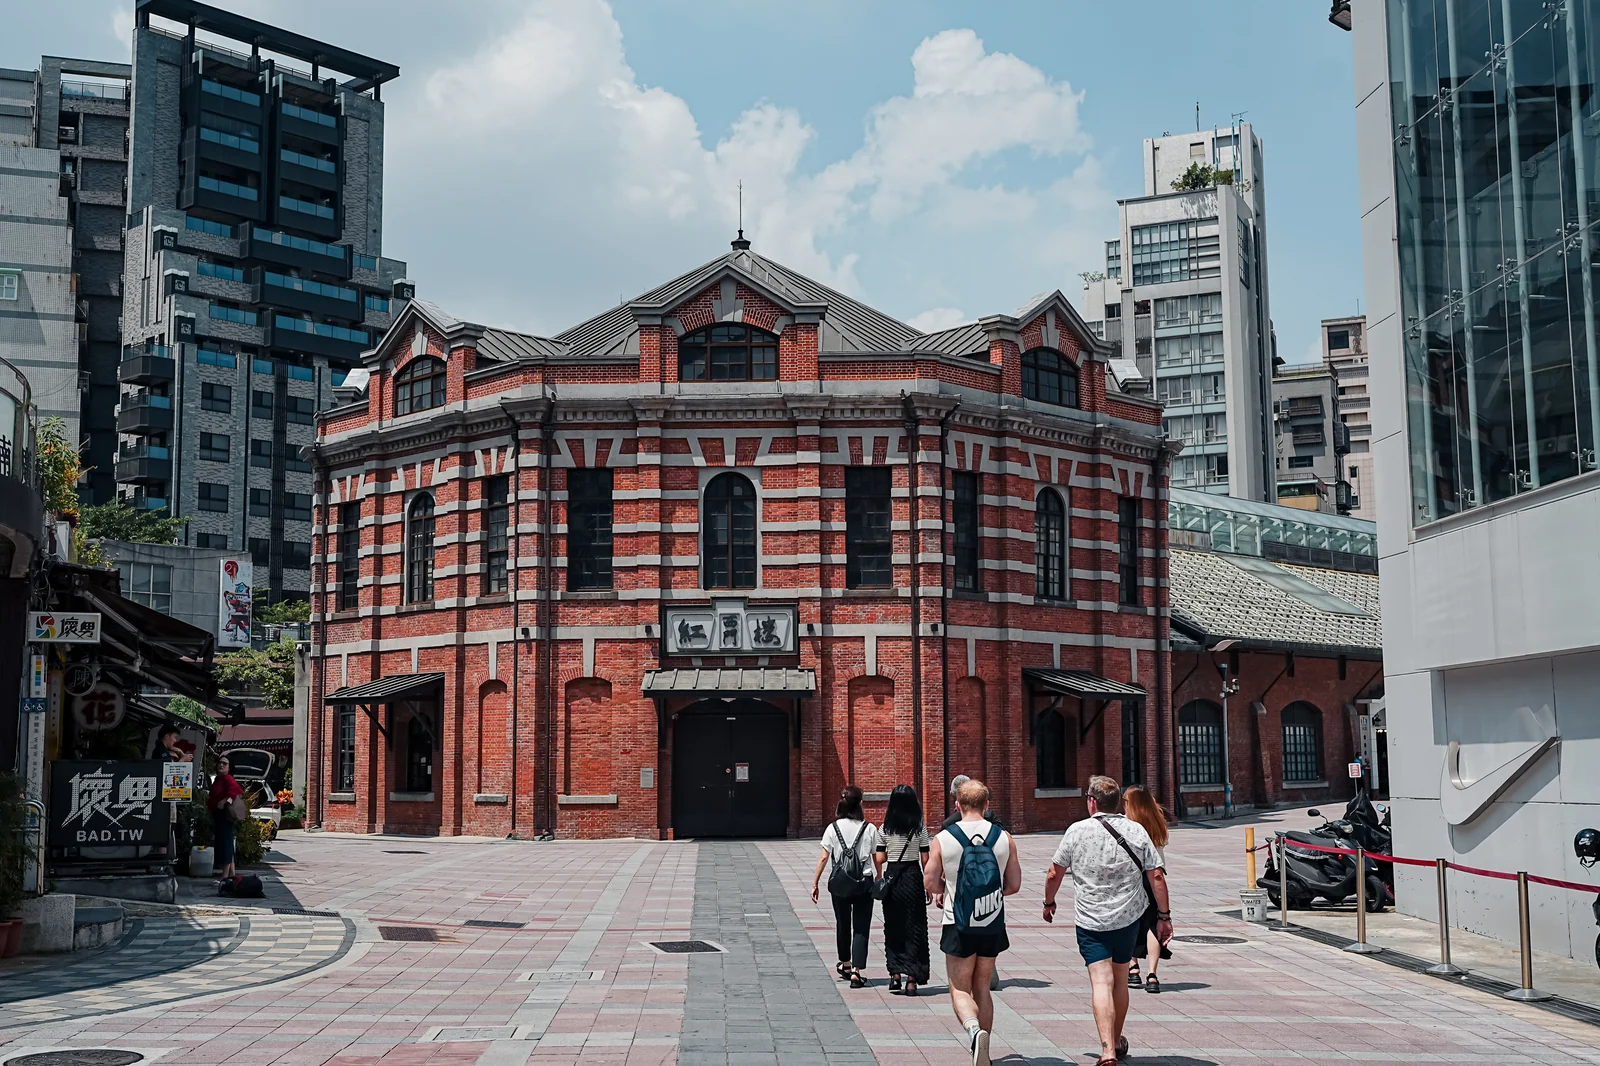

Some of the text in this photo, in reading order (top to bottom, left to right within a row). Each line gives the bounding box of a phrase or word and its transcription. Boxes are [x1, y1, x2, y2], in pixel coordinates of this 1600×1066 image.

[678, 619, 707, 645] 紅
[723, 615, 738, 646] 西門
[76, 829, 144, 842] BAD.TW
